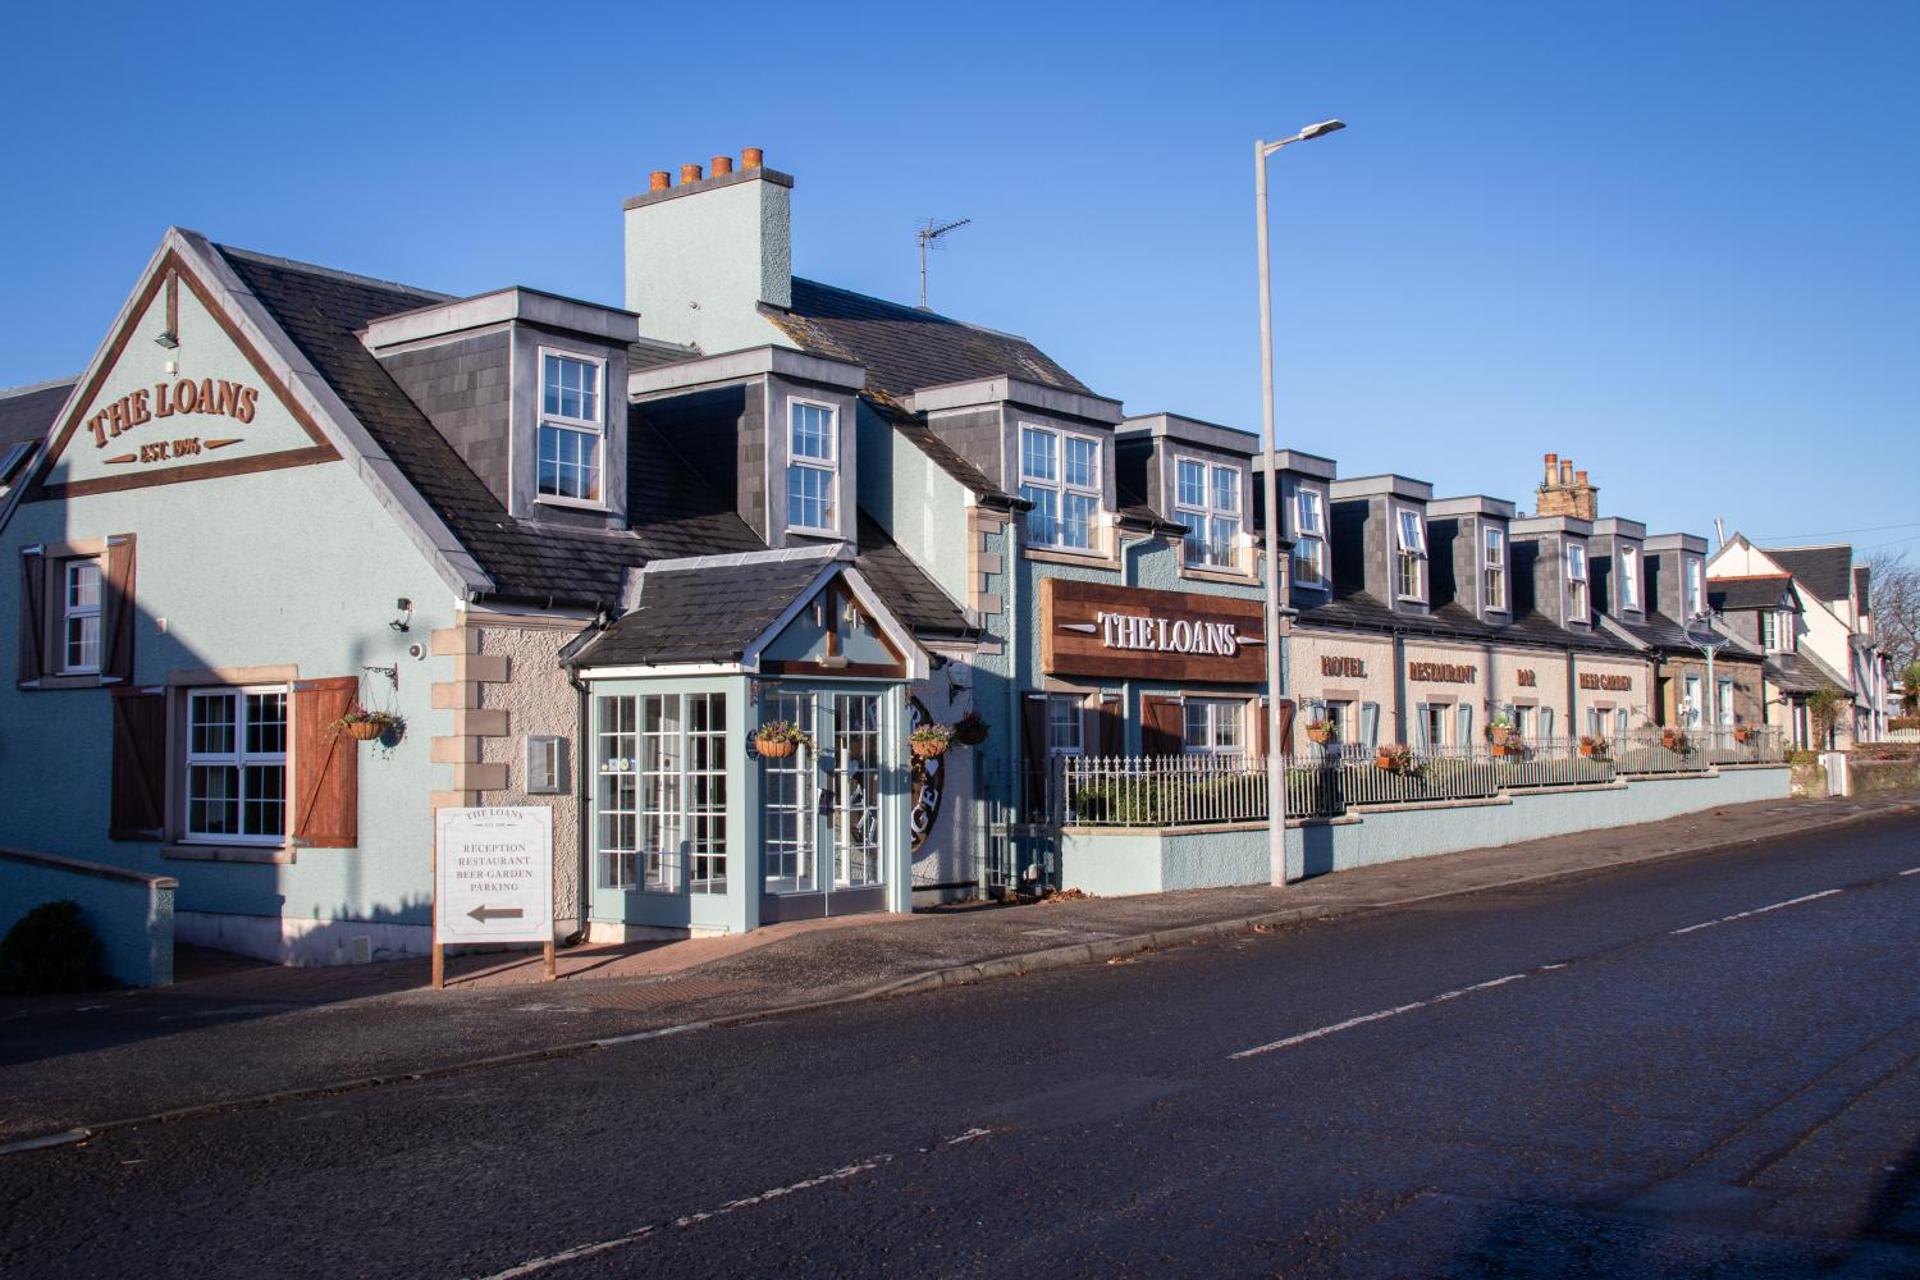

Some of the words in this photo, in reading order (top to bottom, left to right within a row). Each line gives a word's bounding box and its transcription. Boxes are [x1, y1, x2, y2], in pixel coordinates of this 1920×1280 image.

[88, 389, 151, 448] THE
[155, 377, 259, 424] LOANS
[140, 440, 170, 463] EST.
[1097, 611, 1156, 650] THE
[1157, 619, 1237, 656] LOANS
[1320, 655, 1368, 679] HOTEL
[1409, 661, 1477, 684] RESTAURANT
[464, 844, 526, 853] RECEPTION
[458, 856, 530, 866] RESTAURANT
[456, 869, 484, 879] BEER
[486, 869, 533, 879] GARDEN
[470, 882, 519, 892] PARKING
